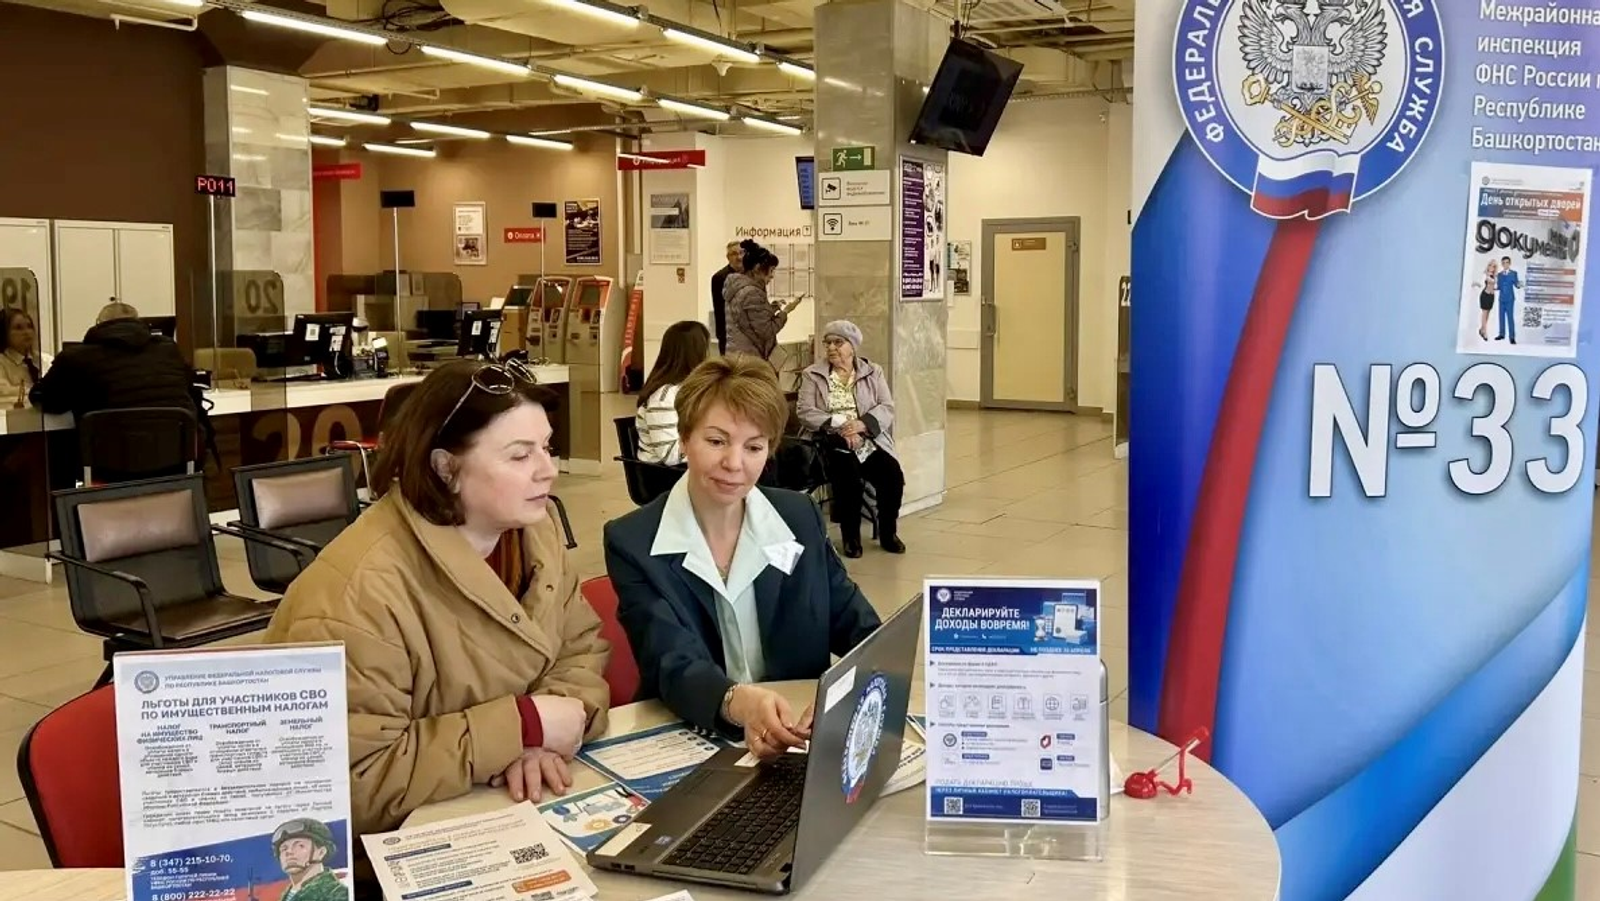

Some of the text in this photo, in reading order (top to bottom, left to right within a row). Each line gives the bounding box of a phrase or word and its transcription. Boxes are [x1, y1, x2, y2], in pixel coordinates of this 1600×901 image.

[1477, 36, 1582, 58] инспекция
[1475, 63, 1518, 85] ФНС
[1523, 65, 1591, 88] России
[1386, 37, 1434, 152] СЛУЖБА
[1473, 94, 1586, 123] Республике
[1471, 126, 1600, 154] Башкортостан
[1480, 192, 1503, 206] День
[1505, 196, 1549, 209] открытых
[1550, 197, 1581, 210] дверей
[735, 226, 801, 238] Информация
[941, 606, 1020, 619] ДЕКЛАРИРУЙТЕ
[934, 619, 1030, 631] ДОХОДЫ ВОВРЕМЯ!
[164, 673, 206, 681] УПРАВЛЕНИЕ
[207, 671, 254, 680] ФЕДЕРАЛЬНОЙ
[255, 669, 293, 677] НАЛОГОВОЙ
[175, 680, 217, 688] РЕСПУБЛИКЕ
[218, 678, 269, 686] БАШКОРТОСТАН
[141, 689, 328, 709] ЛЬГОТЫ ДЛЯ УЧАСТНИКОВ СВО
[141, 701, 329, 720] ПО ИМУЩЕСТВЕННЫМ НАЛОГАМ
[226, 727, 249, 735] НАЛОГ
[289, 723, 313, 731] НАЛОГ
[150, 854, 234, 868] 8 (347) 215-10-70,
[160, 892, 186, 901] (800)
